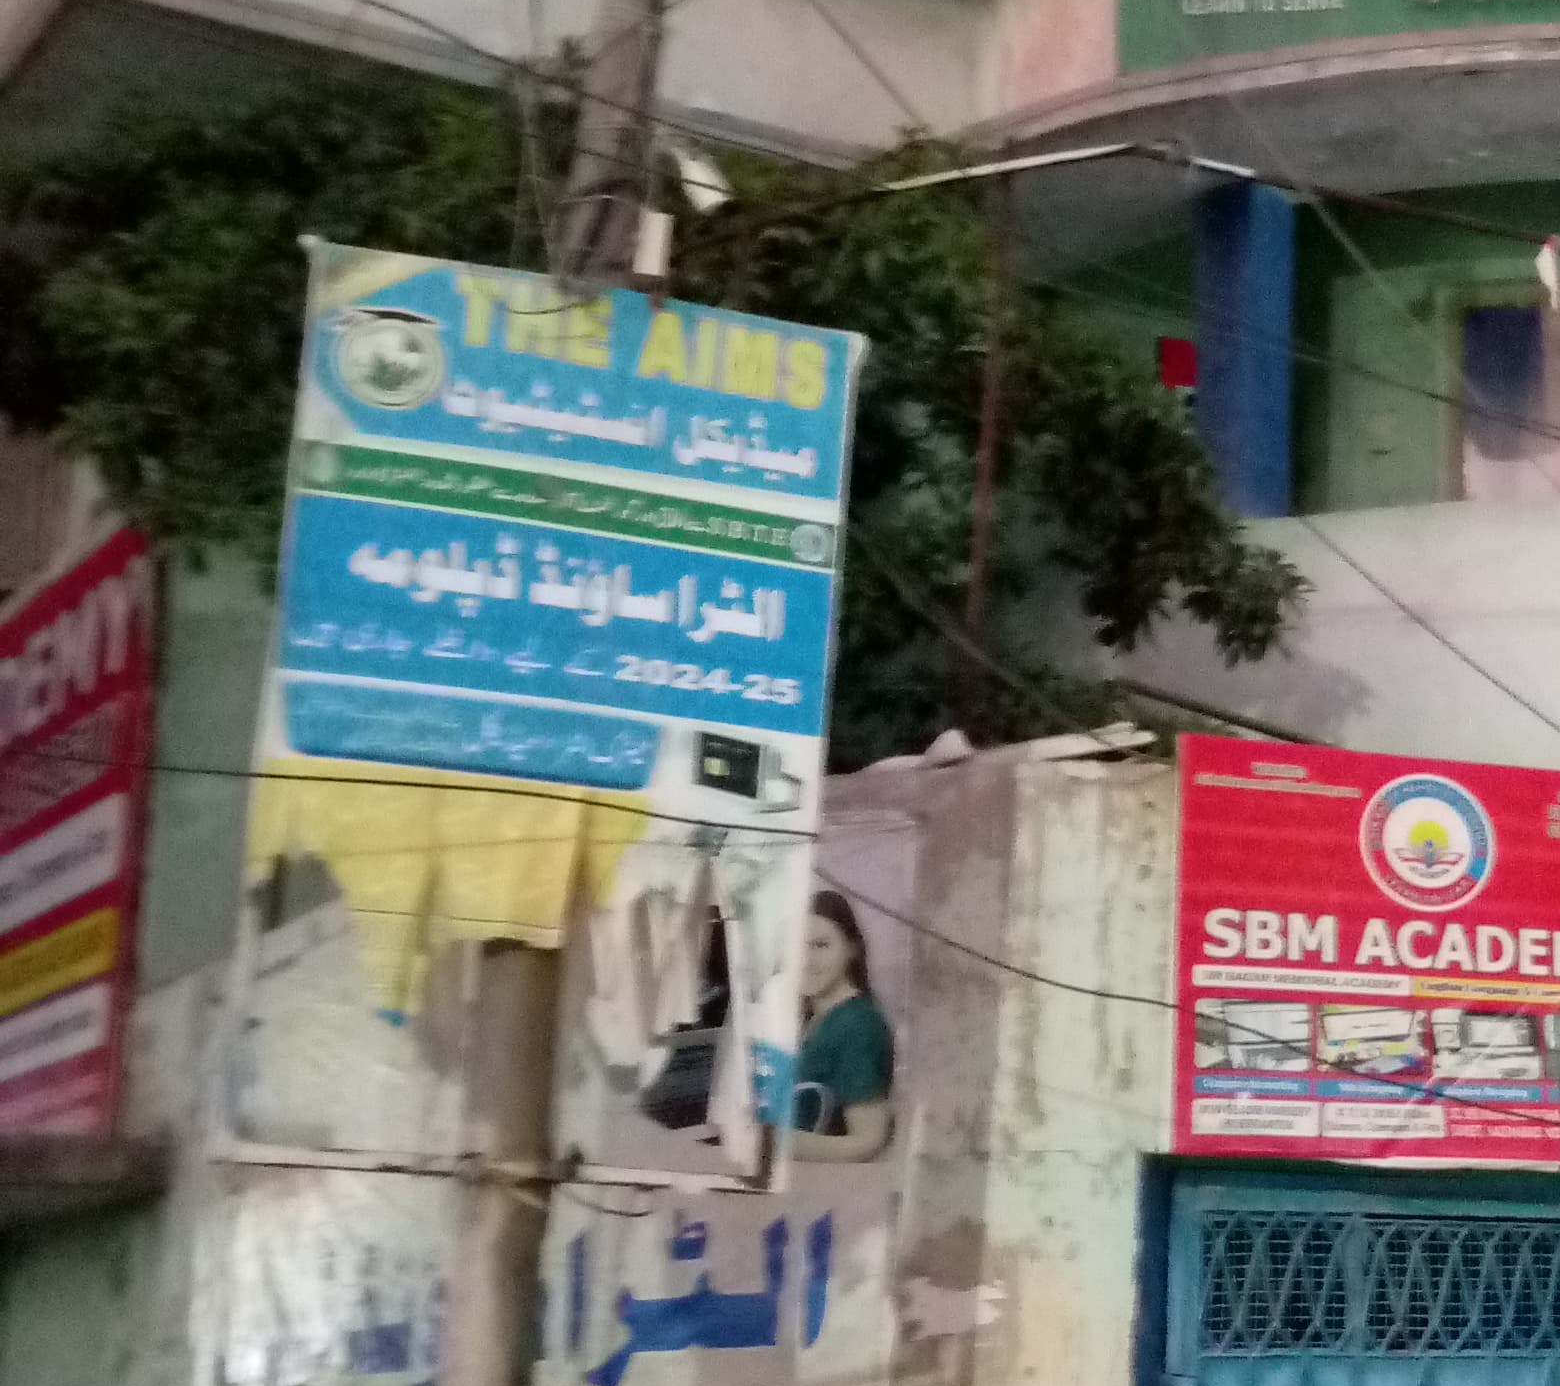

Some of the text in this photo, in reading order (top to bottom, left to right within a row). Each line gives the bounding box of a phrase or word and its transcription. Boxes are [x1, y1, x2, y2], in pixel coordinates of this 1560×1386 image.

[457, 275, 826, 411] THE AIMS
[613, 654, 801, 705] 2024-25
[1203, 907, 1339, 964] SBM
